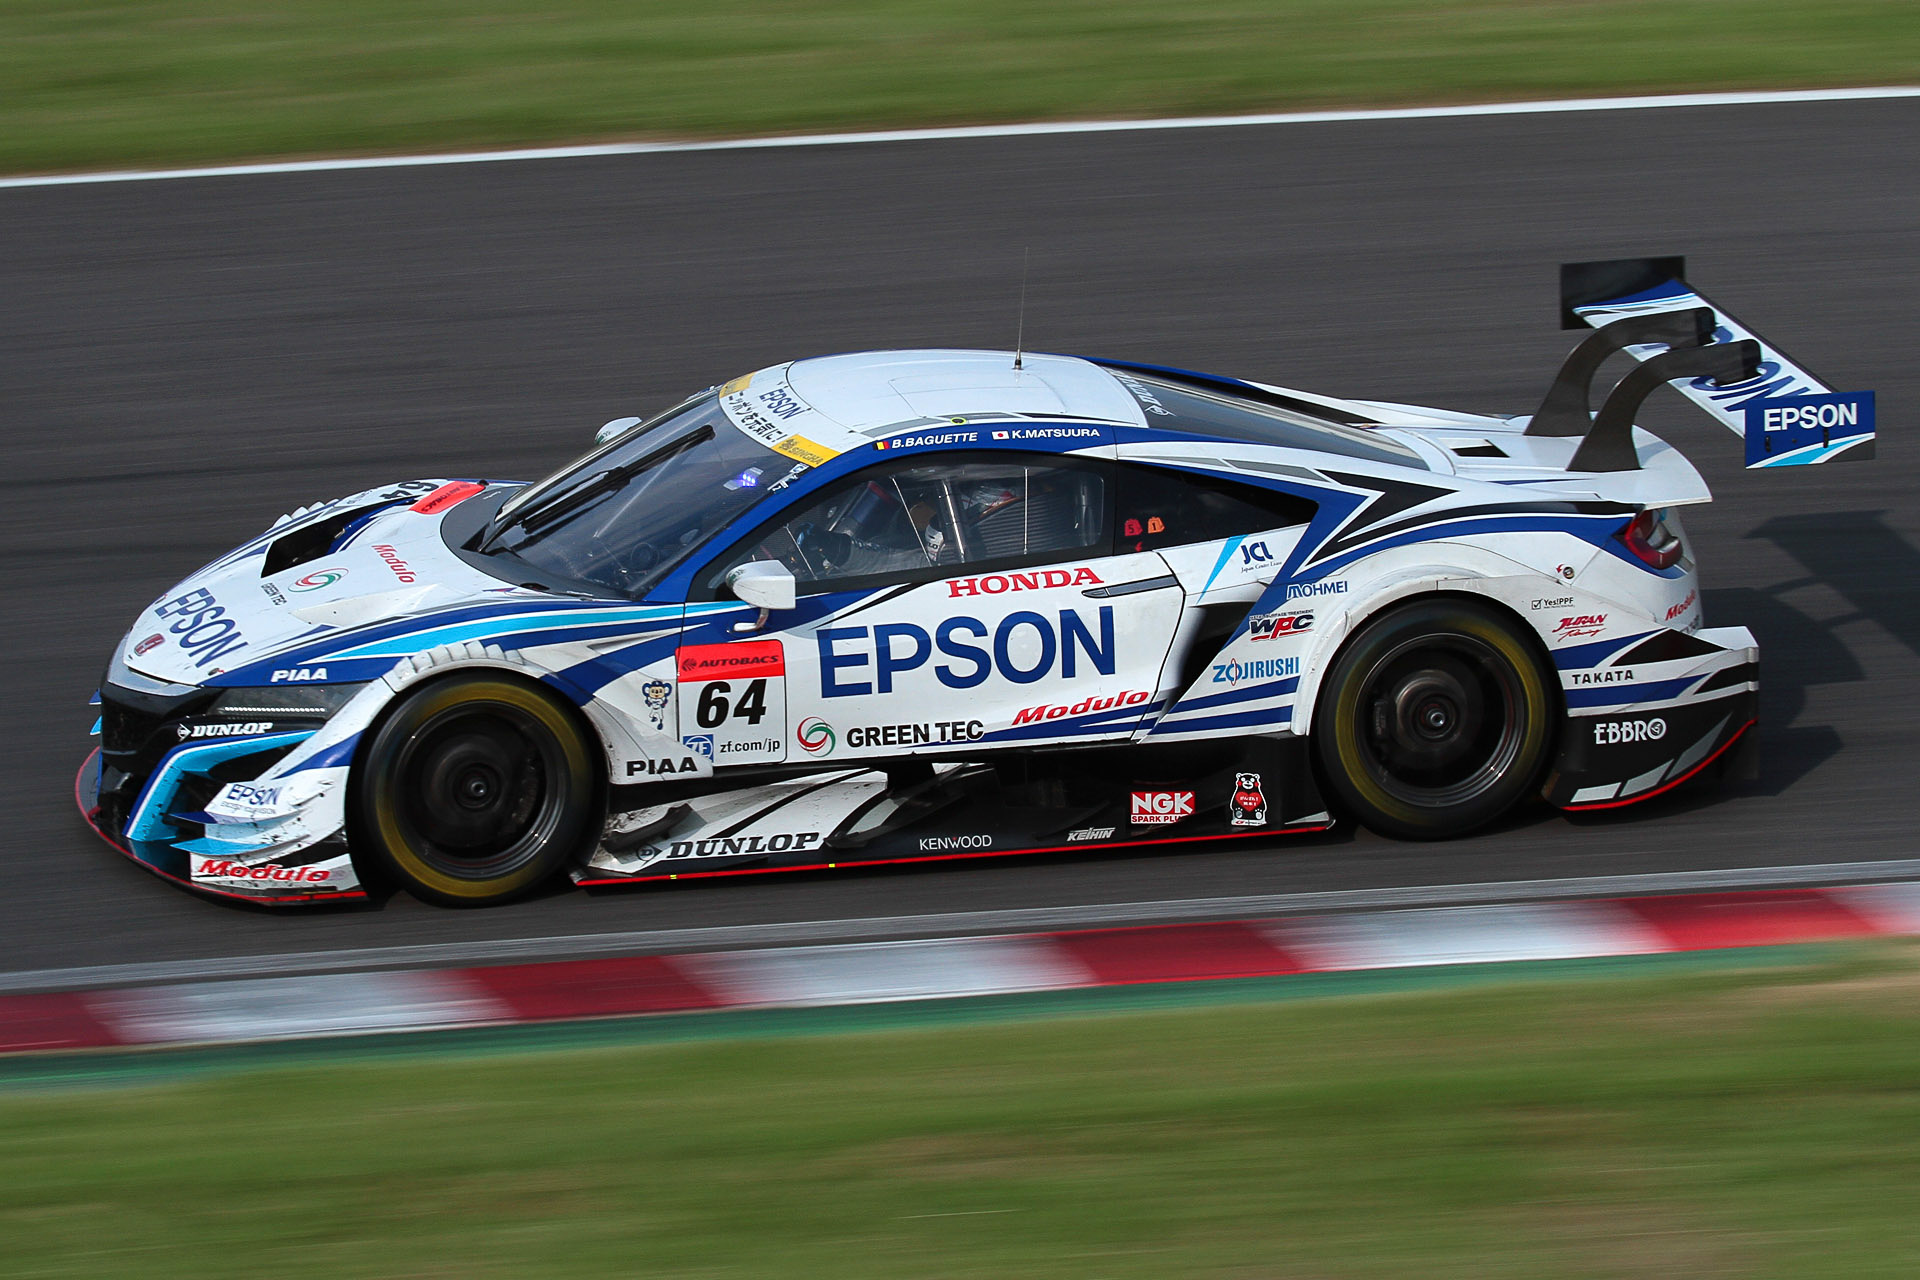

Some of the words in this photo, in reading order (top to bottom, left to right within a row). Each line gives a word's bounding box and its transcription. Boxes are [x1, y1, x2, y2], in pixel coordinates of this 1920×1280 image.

[759, 388, 805, 420] EPSON
[1764, 403, 1857, 432] EPSON
[891, 432, 978, 449] B.BAGUETTE
[1012, 428, 1101, 439] K.MATSUURA
[788, 446, 824, 464] SINGHA
[1240, 541, 1274, 565] JCL
[371, 544, 417, 583] Modulo
[261, 582, 280, 597] GREEN
[945, 567, 1104, 598] HONDA
[1287, 581, 1348, 599] MOHMEI
[1543, 597, 1574, 606] Yes!PPF
[155, 587, 248, 669] EPSON
[1552, 613, 1608, 633] JURAN
[699, 655, 779, 668] AUTOBACS
[816, 605, 1116, 699] EPSON
[271, 668, 327, 683] PIAA
[1213, 657, 1299, 685] ZOJIRUSHI
[1572, 670, 1634, 685] TAKATA
[696, 679, 767, 729] 64
[1011, 689, 1149, 726] Modulo
[191, 722, 273, 738] DUNLOP
[847, 723, 930, 748] GREEN
[935, 719, 984, 743] TEC
[1594, 717, 1666, 745] EBBRO
[720, 738, 780, 753] zf.com/jp
[626, 757, 698, 776] PIAA
[1132, 792, 1193, 814] NGK
[1131, 815, 1161, 823] SPARK
[919, 834, 992, 850] KENWOOD
[1066, 827, 1116, 842] KEIHIN
[666, 832, 819, 859] DUNLOP
[199, 859, 330, 882] Modulo
